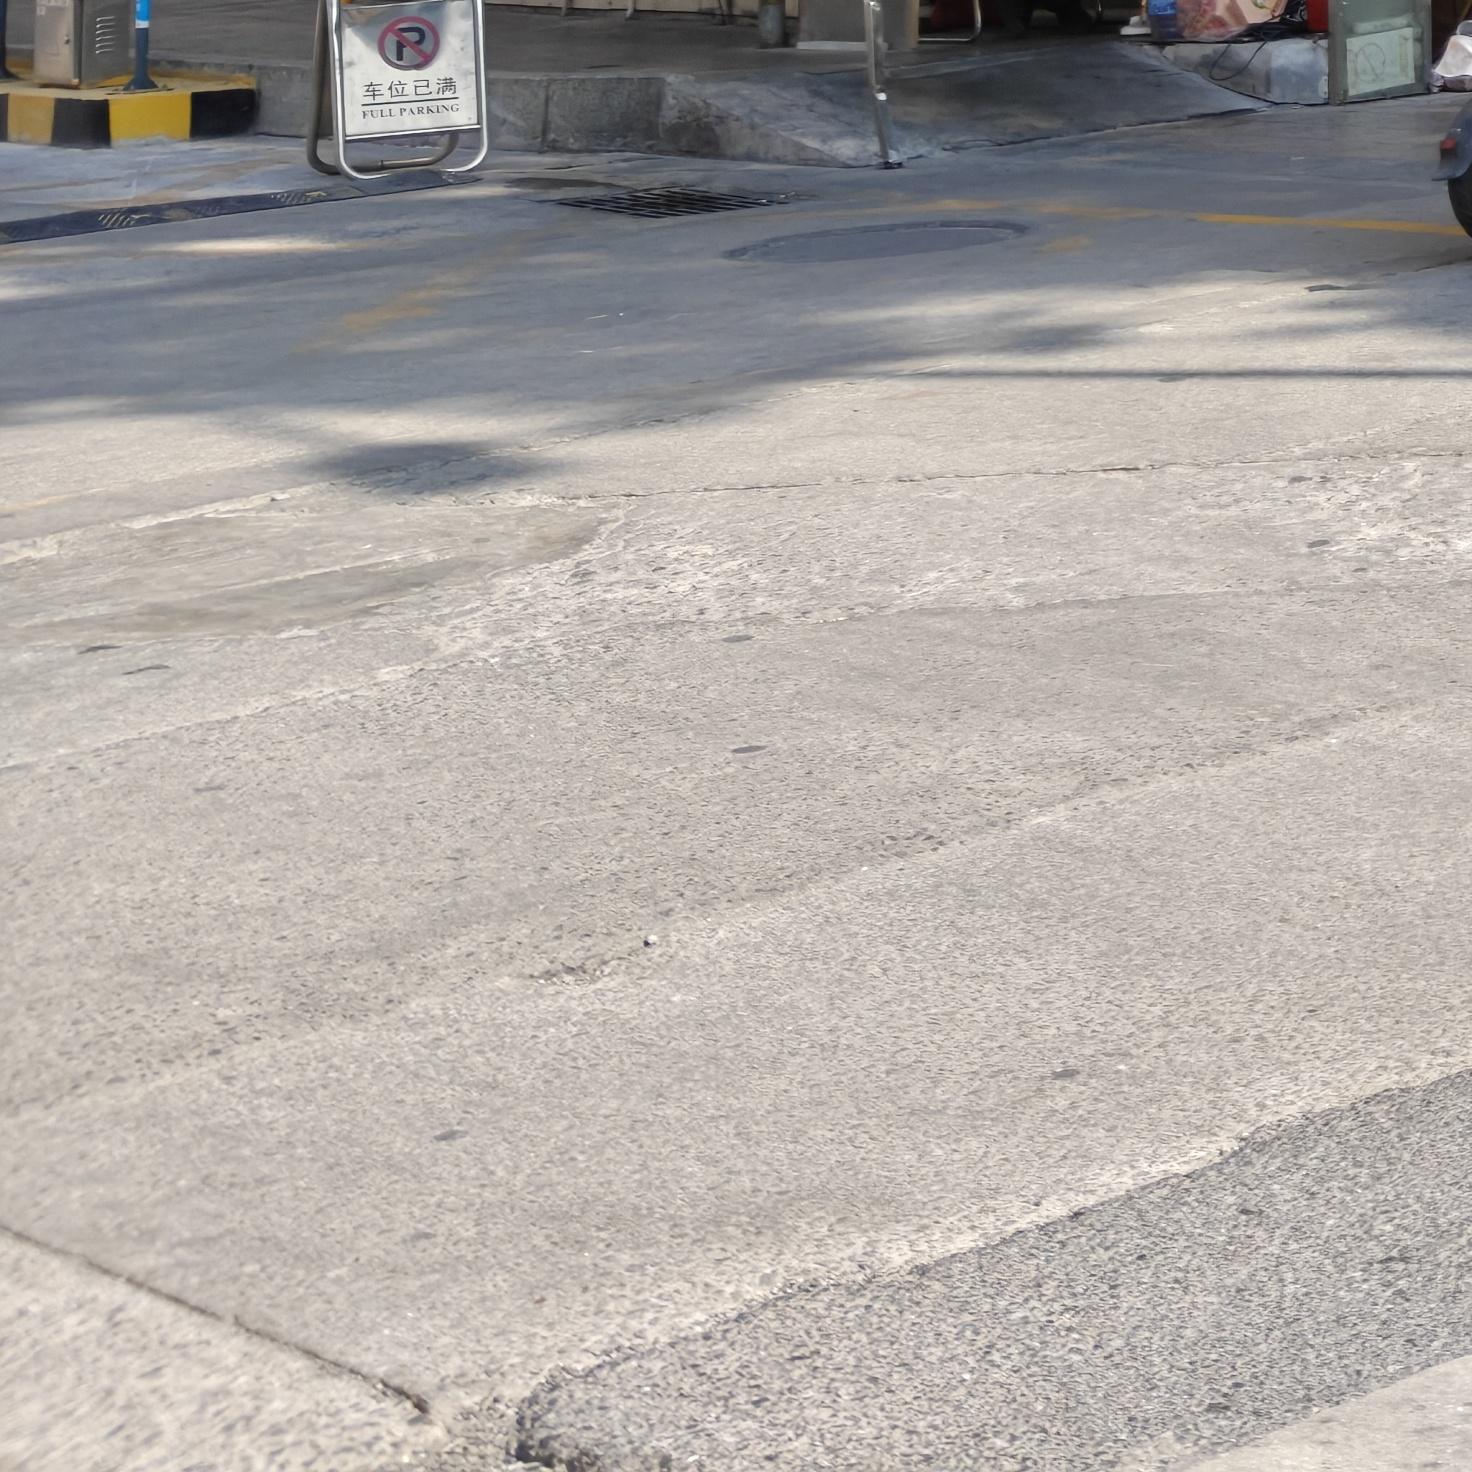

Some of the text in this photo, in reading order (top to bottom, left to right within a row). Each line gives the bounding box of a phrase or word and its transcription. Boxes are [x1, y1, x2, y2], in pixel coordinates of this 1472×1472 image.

[362, 75, 458, 102] 车位已满
[361, 101, 461, 121] FULL PARKING
